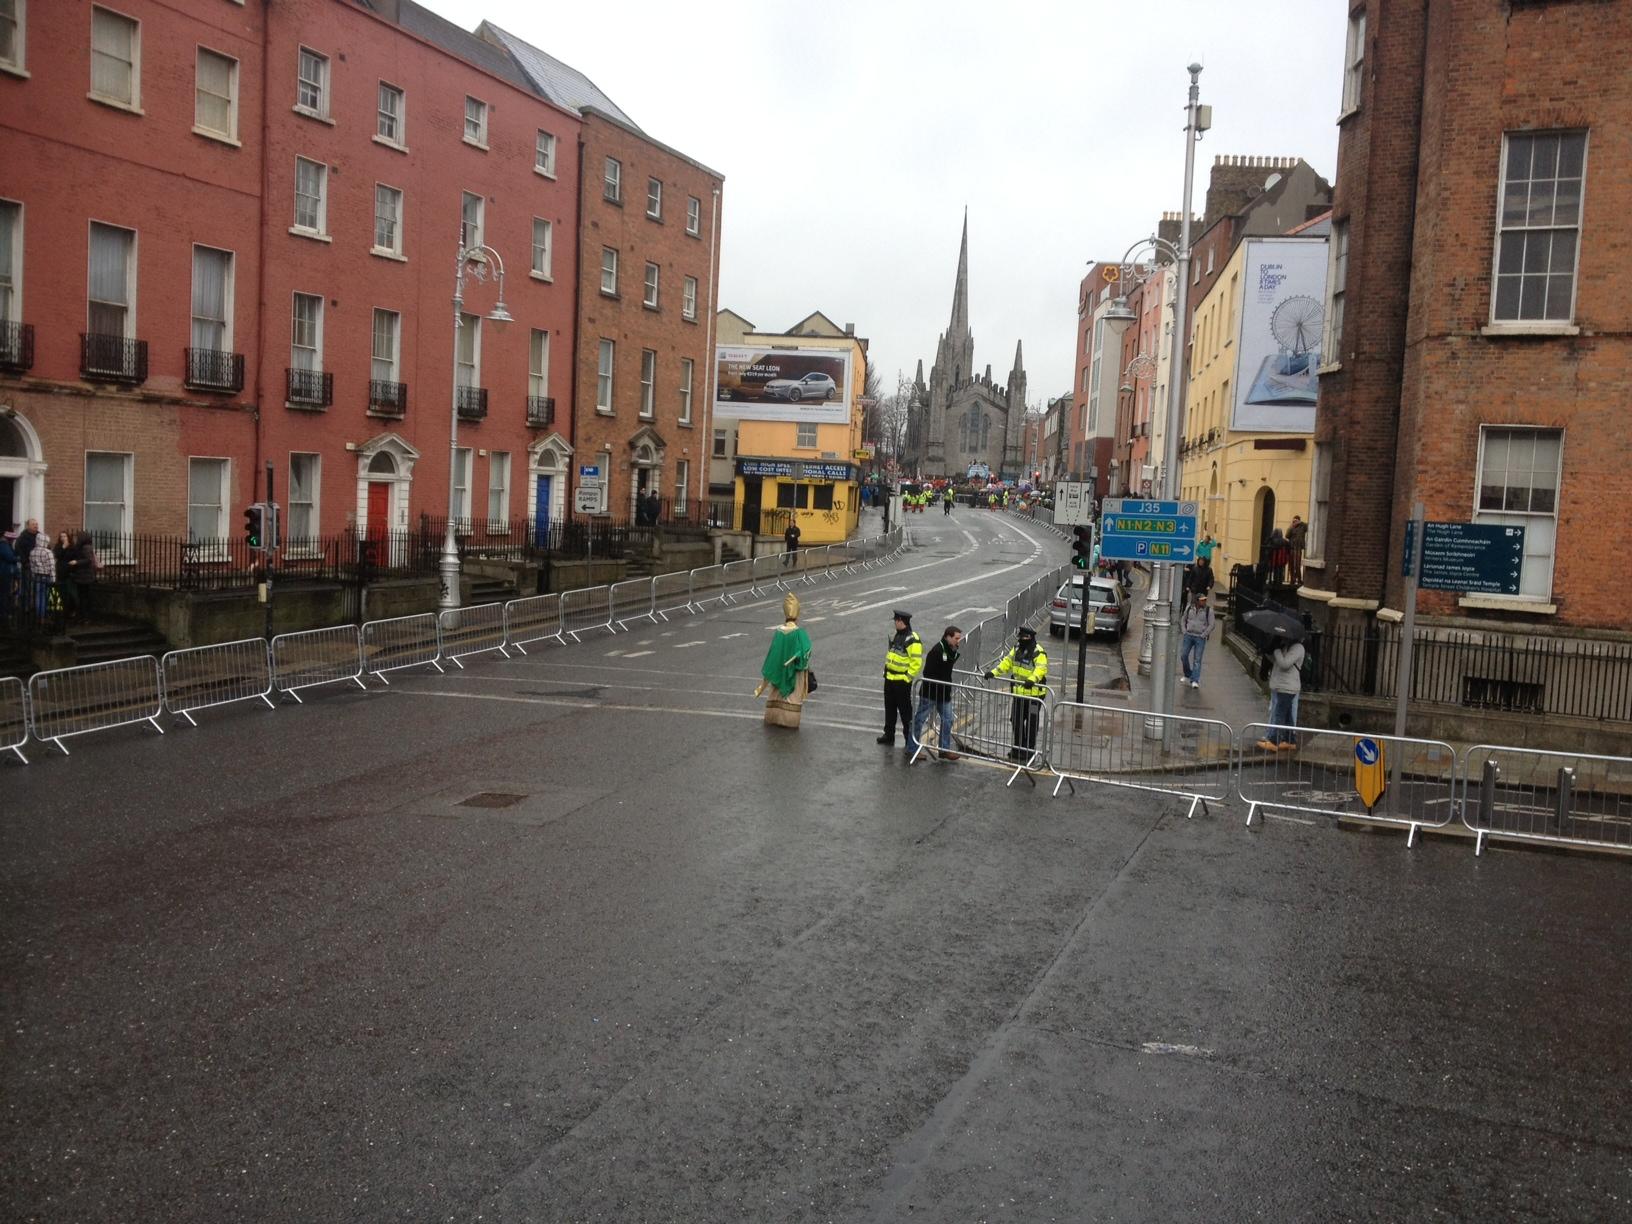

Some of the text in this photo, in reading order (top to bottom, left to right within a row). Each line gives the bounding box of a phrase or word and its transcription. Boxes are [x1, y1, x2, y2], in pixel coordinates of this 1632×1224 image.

[1139, 502, 1160, 513] J35
[1138, 543, 1169, 555] P N11
